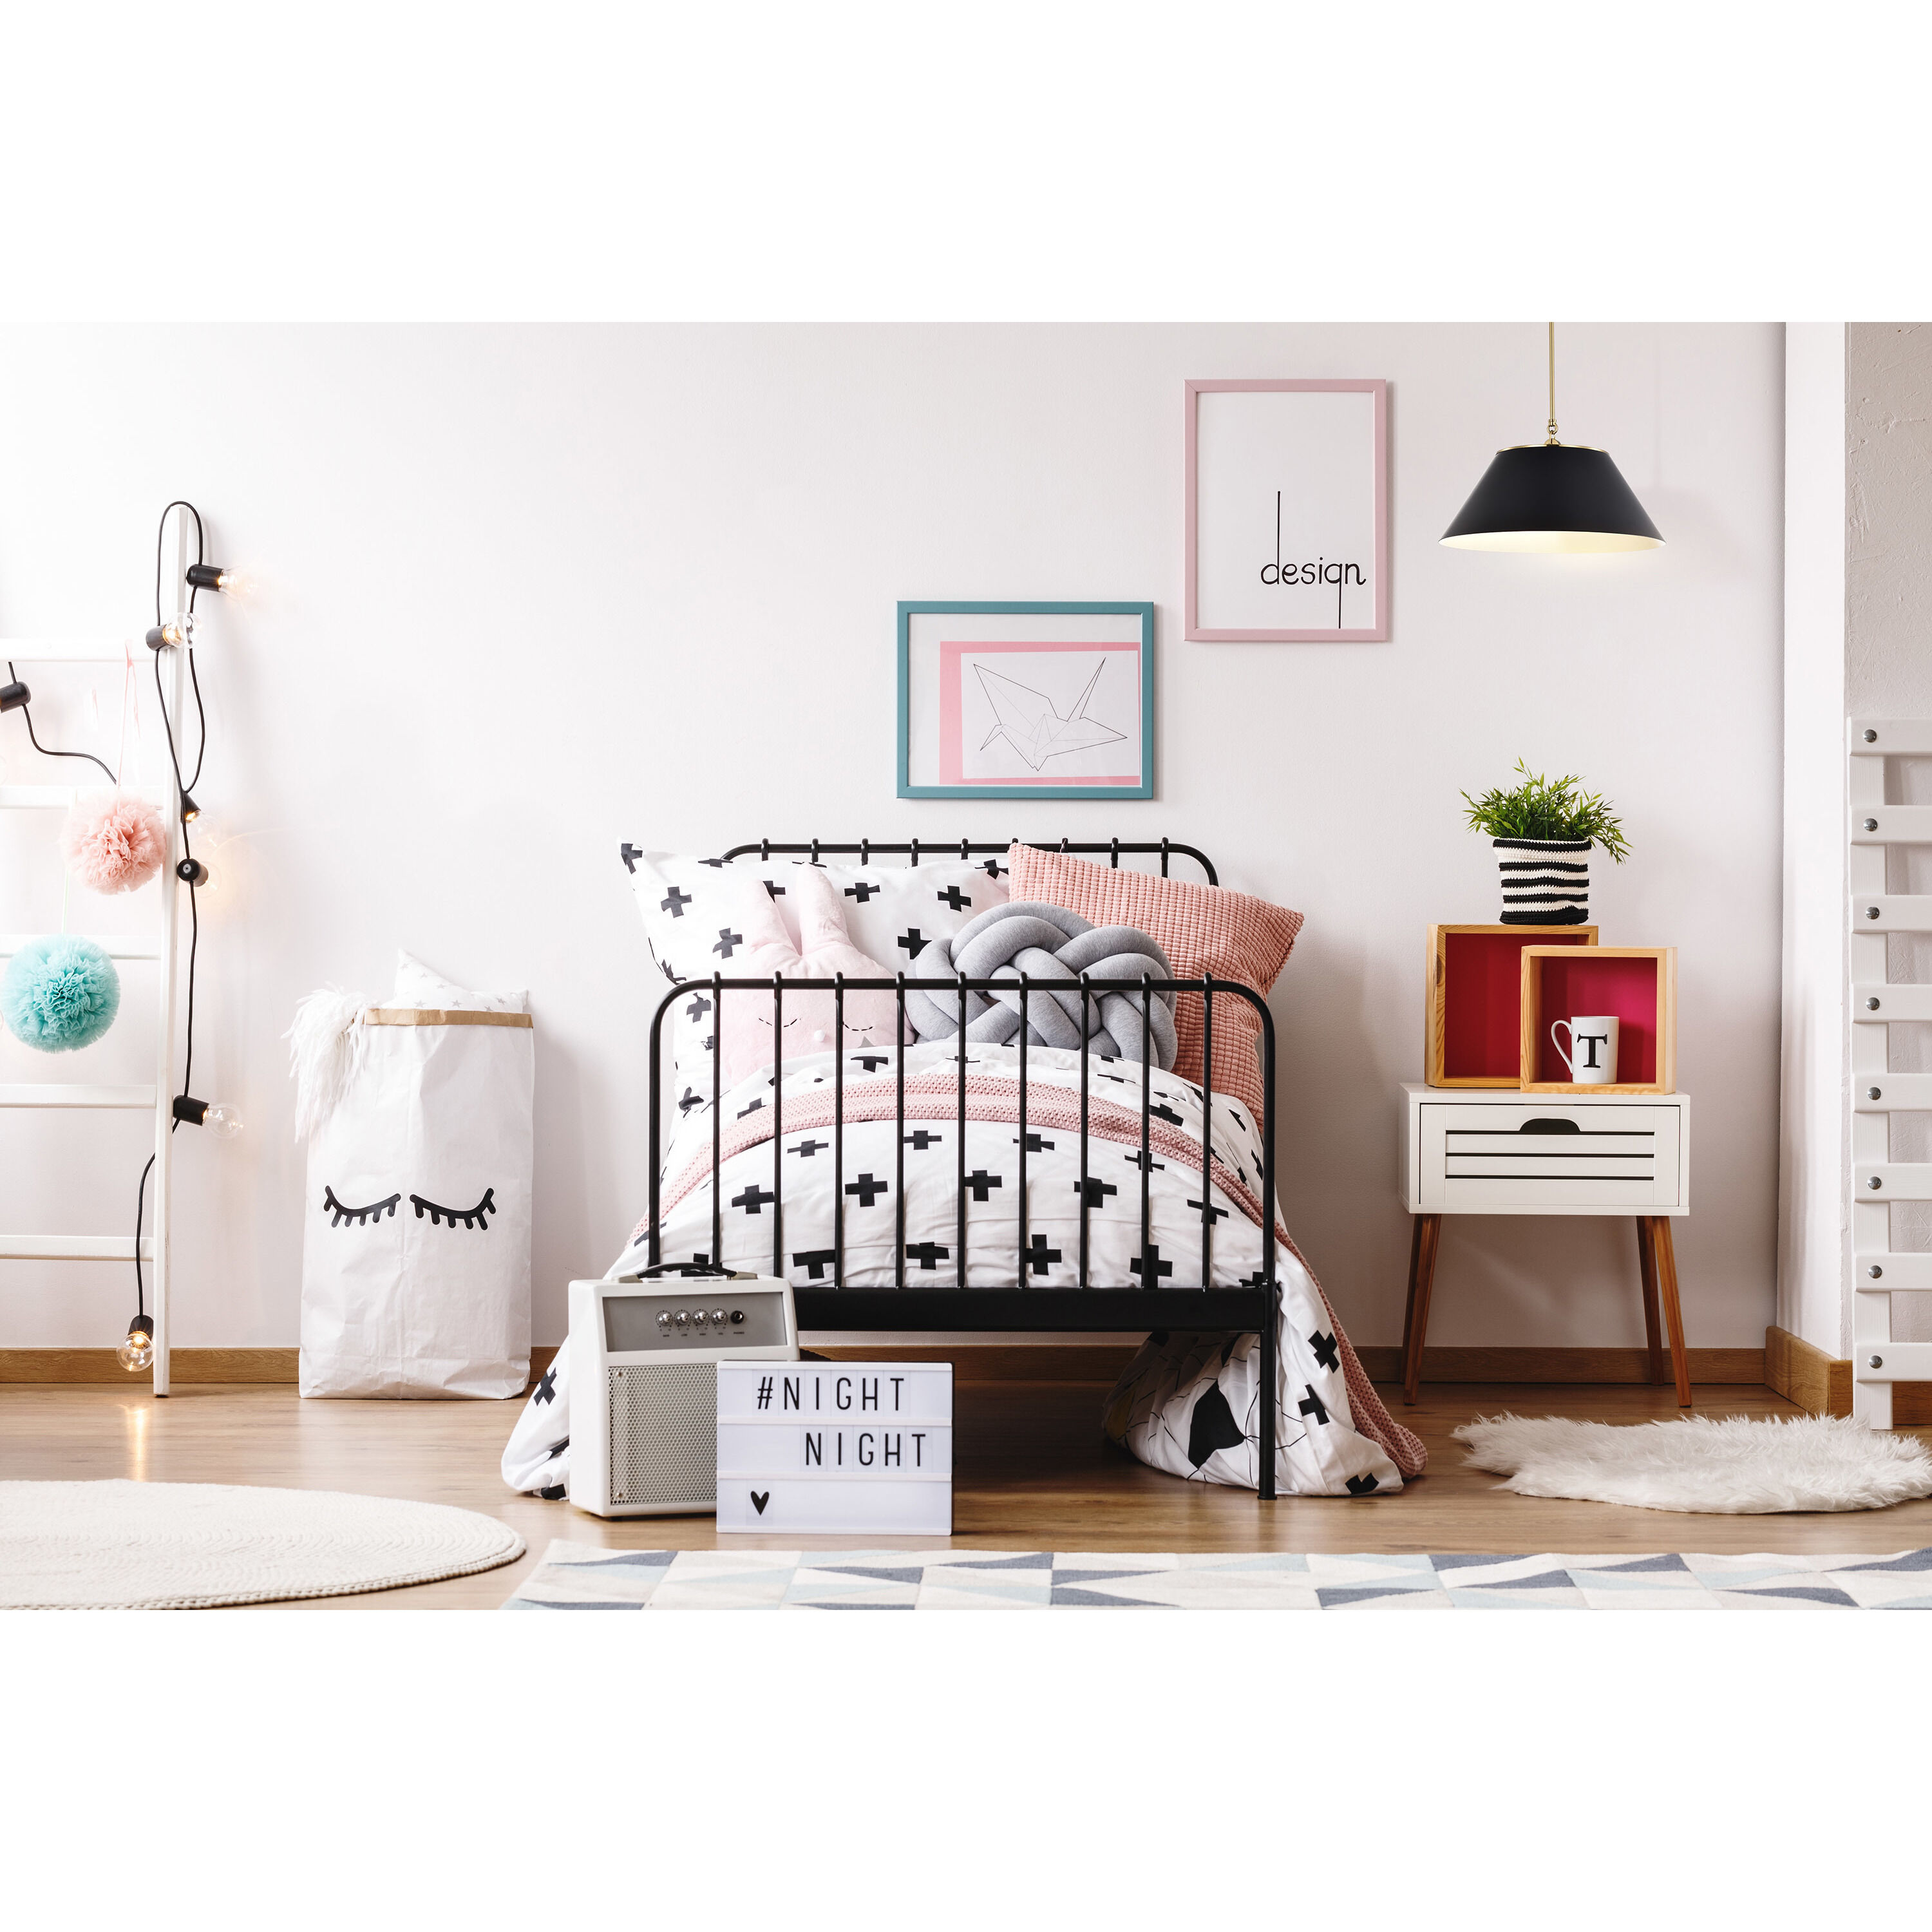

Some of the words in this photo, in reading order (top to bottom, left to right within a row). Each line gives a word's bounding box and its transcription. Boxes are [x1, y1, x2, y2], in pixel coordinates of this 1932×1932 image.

[1260, 491, 1367, 629] design
[1577, 1033, 1608, 1069] T
[757, 1376, 905, 1411] #NIGHT
[805, 1432, 926, 1467] NIGHT
